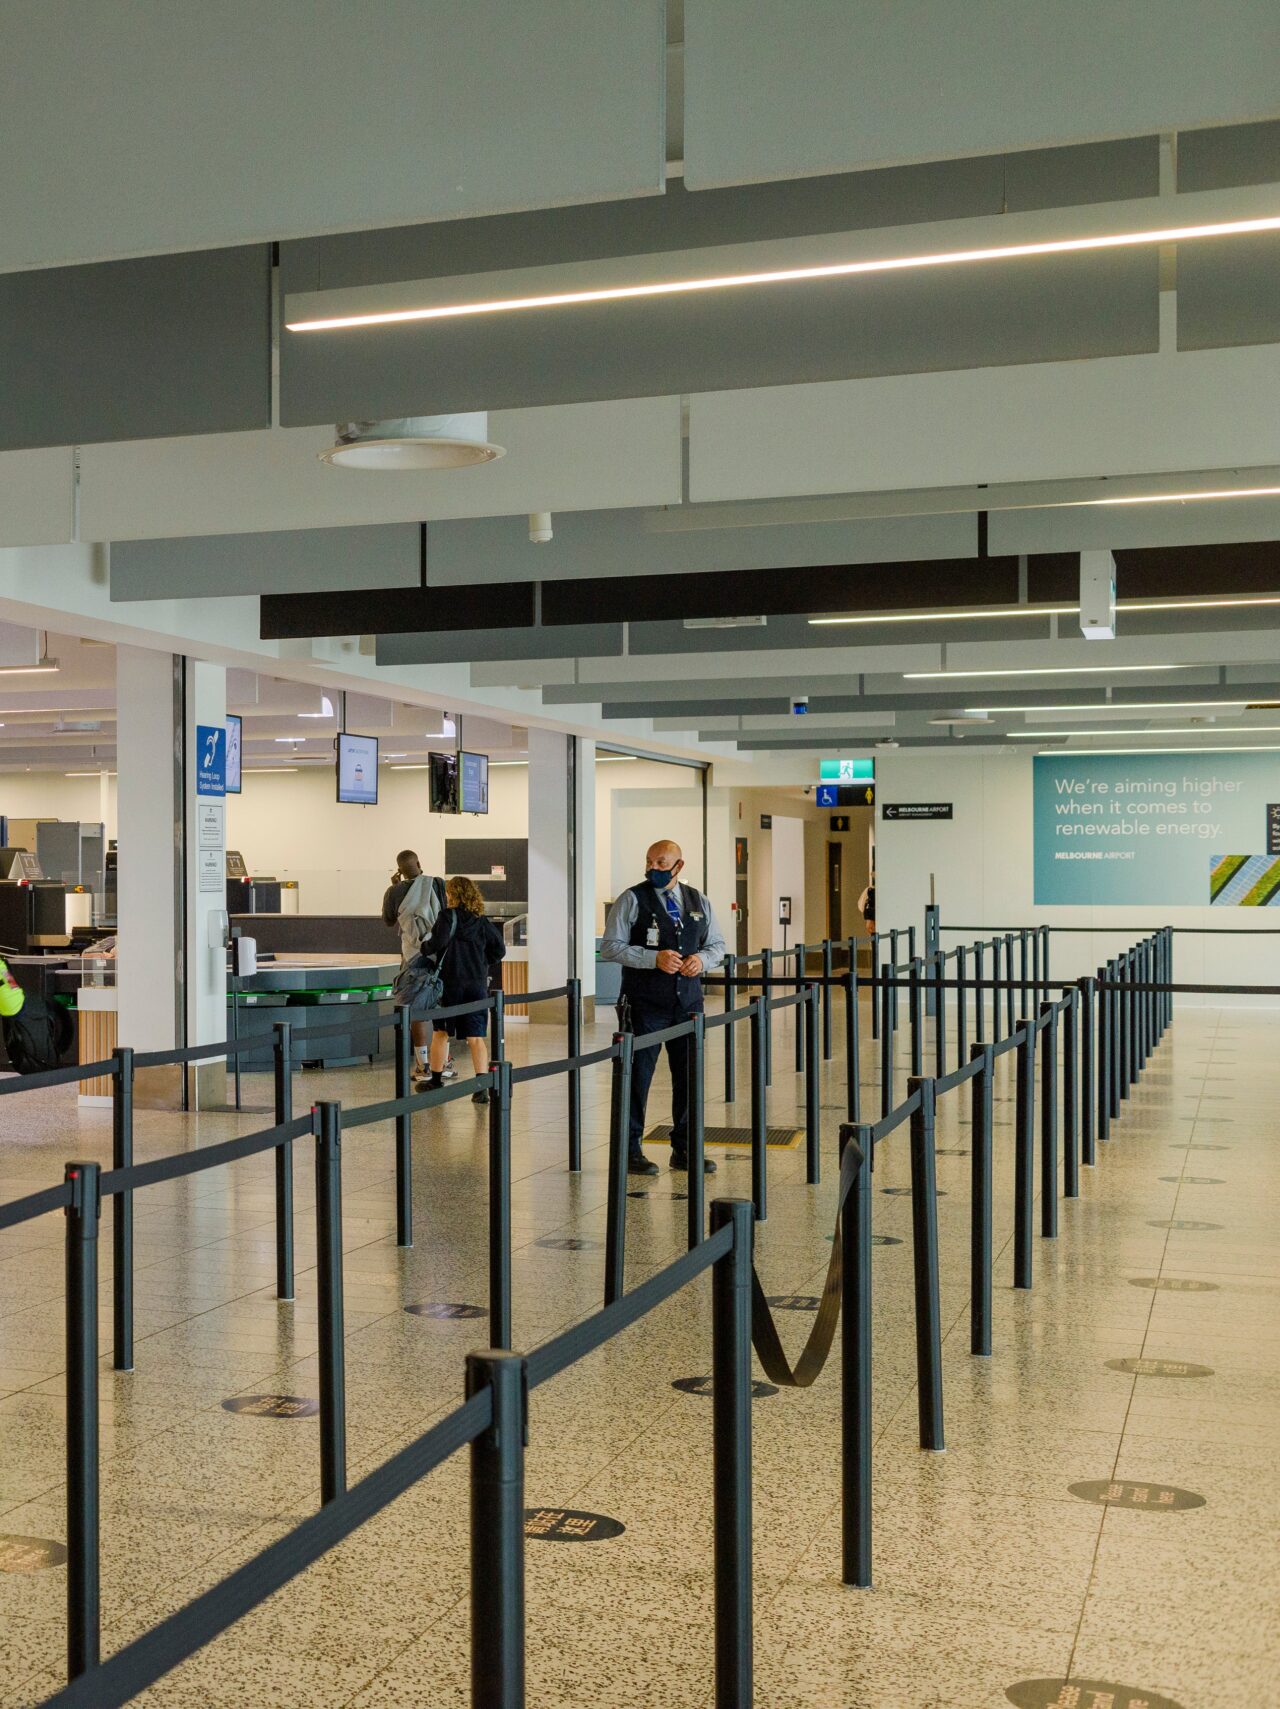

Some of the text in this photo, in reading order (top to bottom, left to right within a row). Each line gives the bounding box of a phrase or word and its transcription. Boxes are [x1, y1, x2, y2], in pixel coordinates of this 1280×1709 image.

[199, 771, 212, 781] Hearing
[1055, 777, 1243, 796] We're aiming higher
[1055, 800, 1212, 815] when it comes to
[1055, 820, 1223, 839] renewable energy.
[1055, 852, 1136, 860] MELBOURNE AIRPORT
